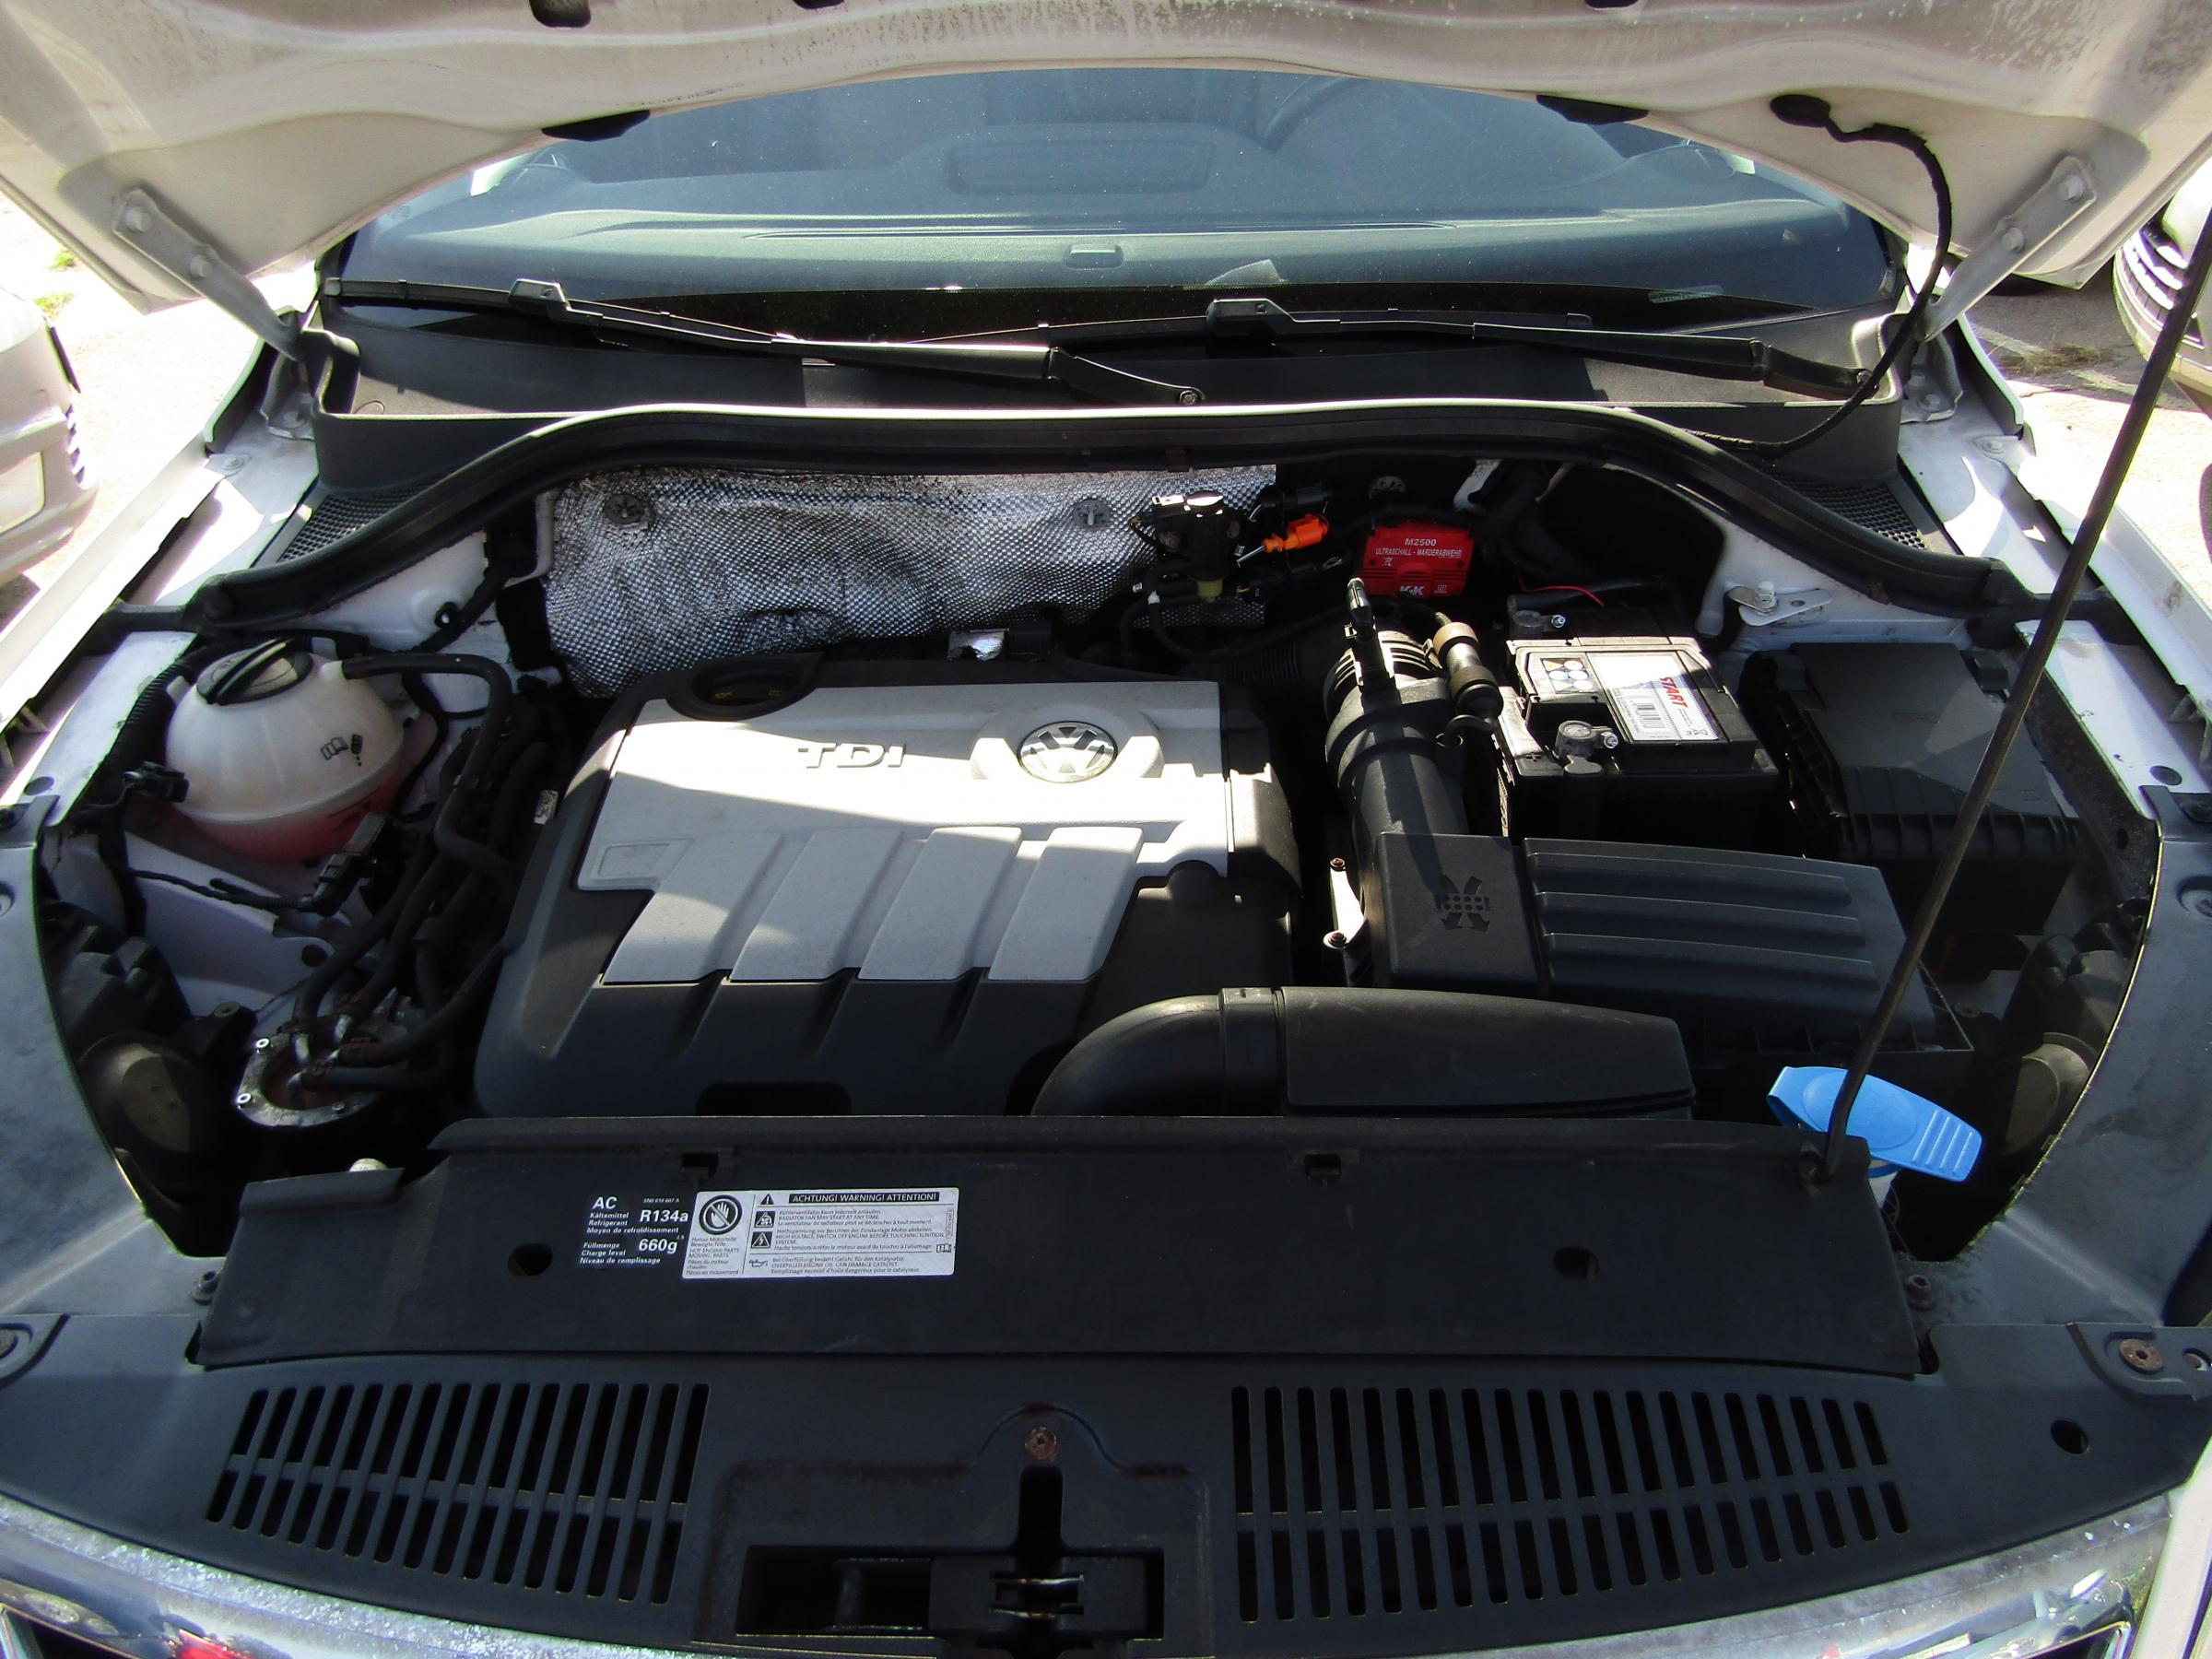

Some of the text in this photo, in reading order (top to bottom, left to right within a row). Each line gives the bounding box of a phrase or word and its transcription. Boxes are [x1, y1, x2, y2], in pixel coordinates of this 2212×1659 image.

[1405, 538, 1437, 547] M2500
[1375, 547, 1412, 556] ULTRASCHALL
[797, 742, 907, 770] TDI
[592, 1196, 618, 1209] AC
[640, 1209, 689, 1223] R134a
[639, 1238, 678, 1254] 660g
